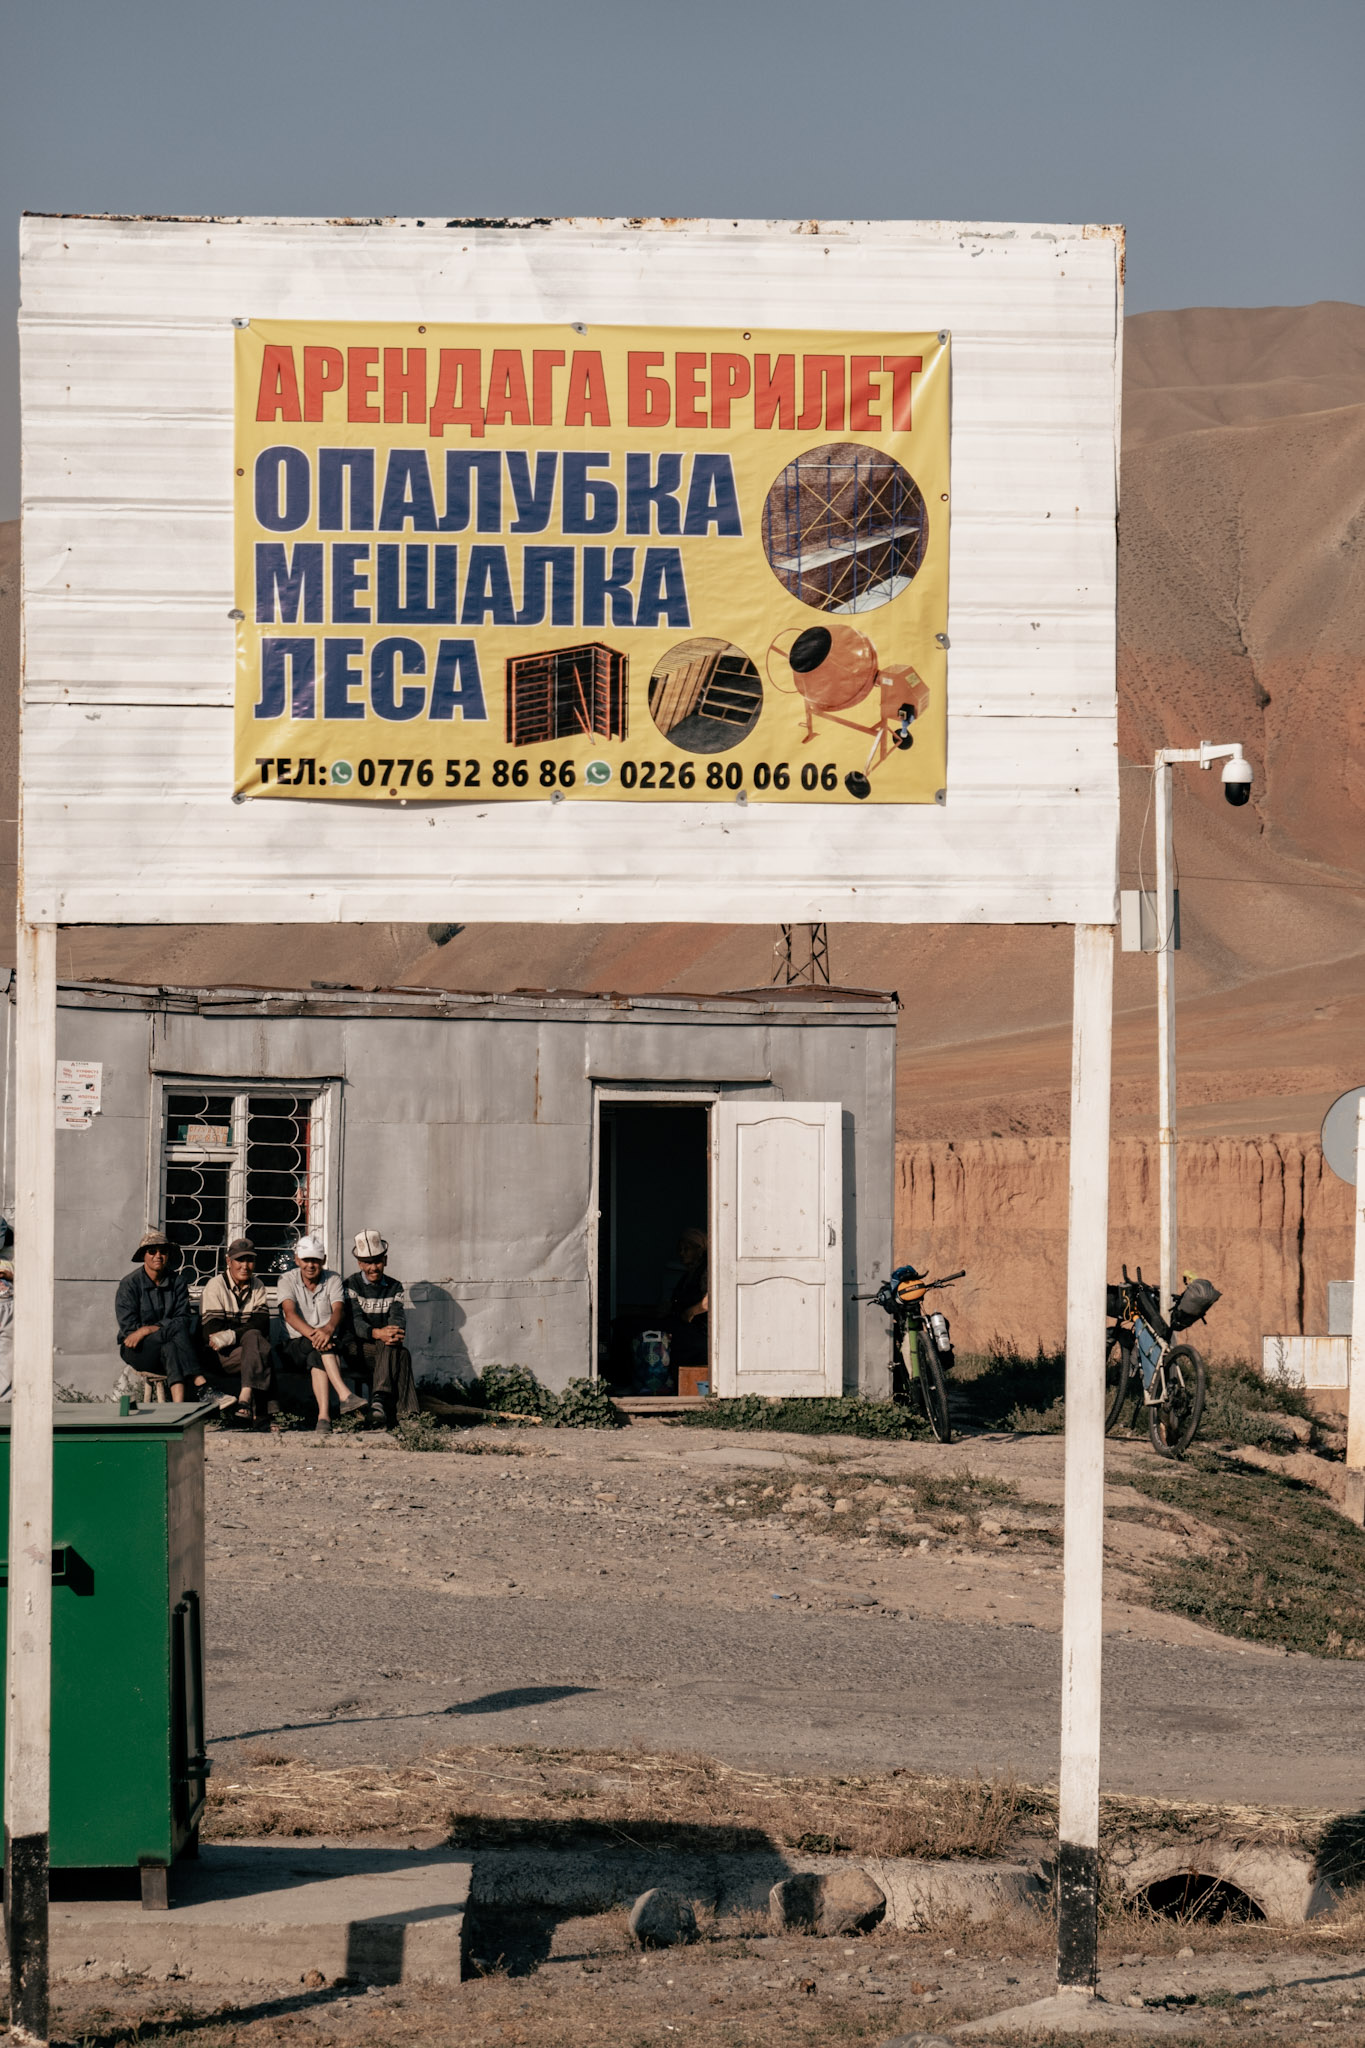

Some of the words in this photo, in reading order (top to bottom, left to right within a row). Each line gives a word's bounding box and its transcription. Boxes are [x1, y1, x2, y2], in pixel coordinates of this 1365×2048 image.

[255, 344, 612, 438] АРЕНДАГА
[626, 350, 923, 433] БЕРИЛЕТ
[254, 445, 744, 537] ОПАЛУБКА
[254, 542, 692, 629] МЕШАЛКА
[254, 637, 488, 721] ЛЕСА
[255, 757, 327, 786] ТЕЛ:
[357, 758, 434, 787] 0776
[445, 758, 481, 787] 52
[491, 759, 529, 787] 86
[538, 759, 576, 788] 86
[619, 760, 696, 790] 0226
[705, 761, 743, 790] 80
[753, 762, 790, 791] 06
[800, 763, 838, 791] 06
